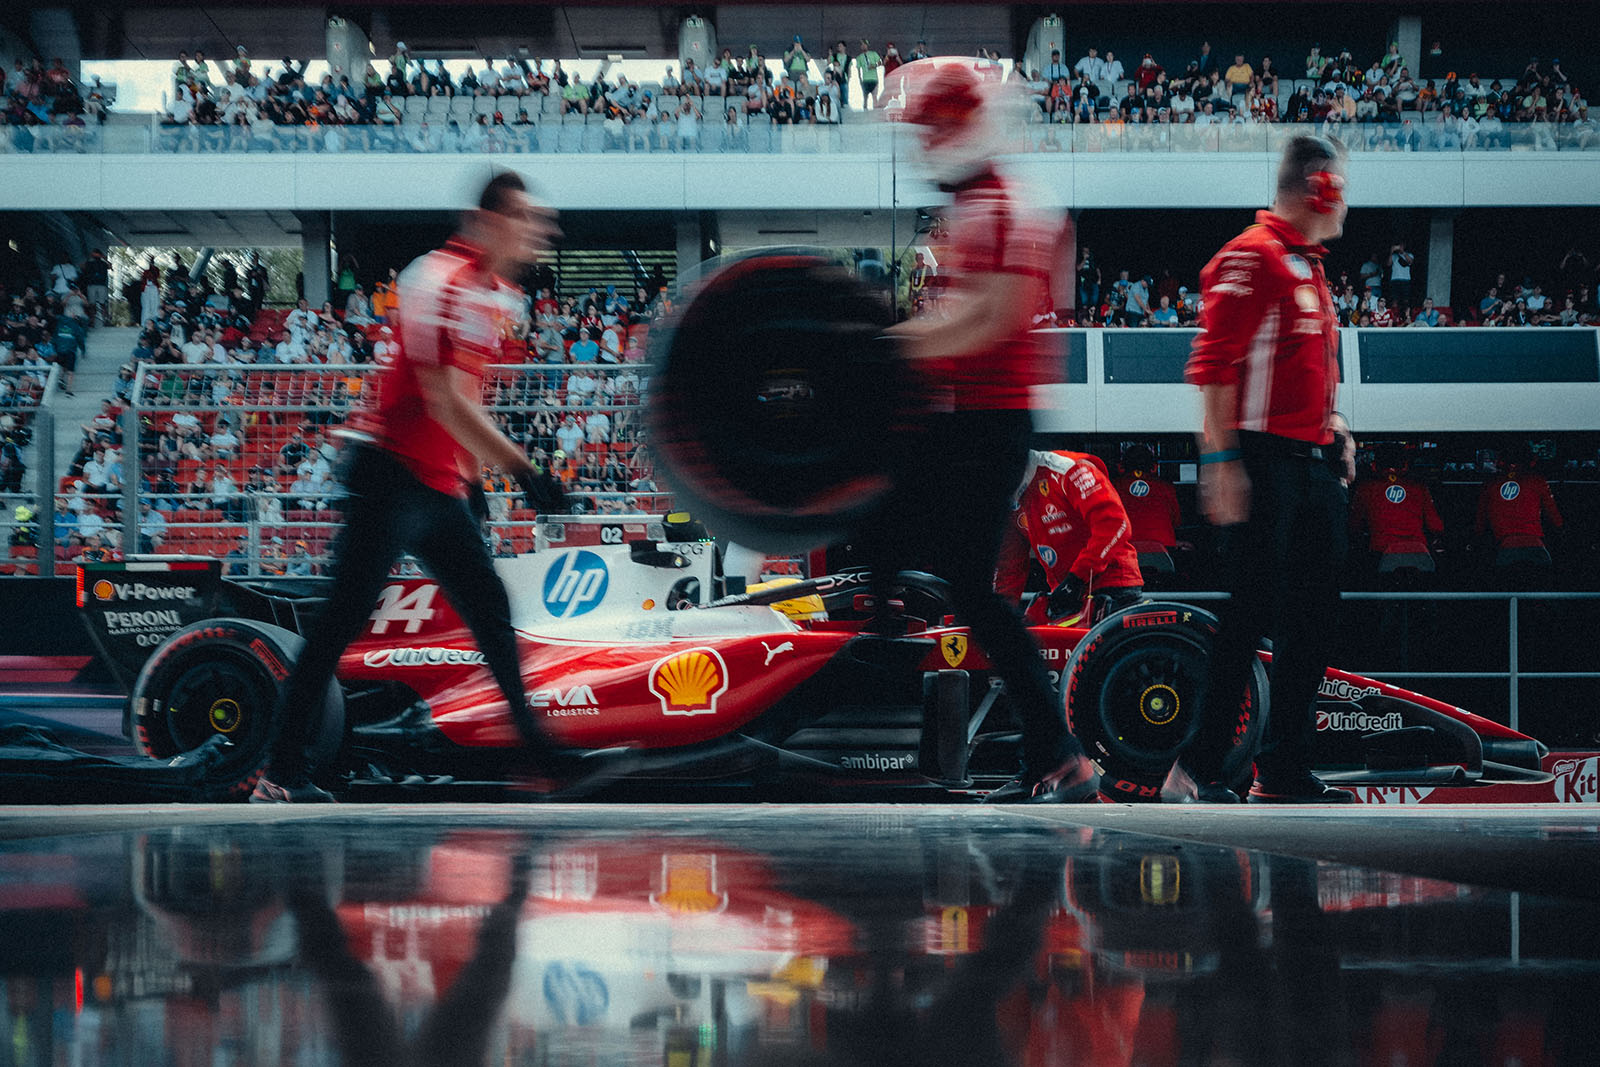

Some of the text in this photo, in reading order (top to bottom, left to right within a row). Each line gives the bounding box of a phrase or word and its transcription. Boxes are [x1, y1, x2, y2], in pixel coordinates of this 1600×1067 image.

[1131, 480, 1148, 497] hp
[1388, 486, 1404, 502] hp
[1503, 482, 1518, 499] hp
[601, 526, 623, 544] 02
[114, 583, 197, 600] V-Power
[546, 549, 606, 618] hp
[104, 609, 182, 629] PERONI
[1122, 610, 1178, 629] PIRELLI
[135, 633, 168, 648] 0.0
[546, 707, 601, 717] LOGISTICS
[1329, 711, 1403, 731] UniCredit
[840, 753, 905, 772] ambipar
